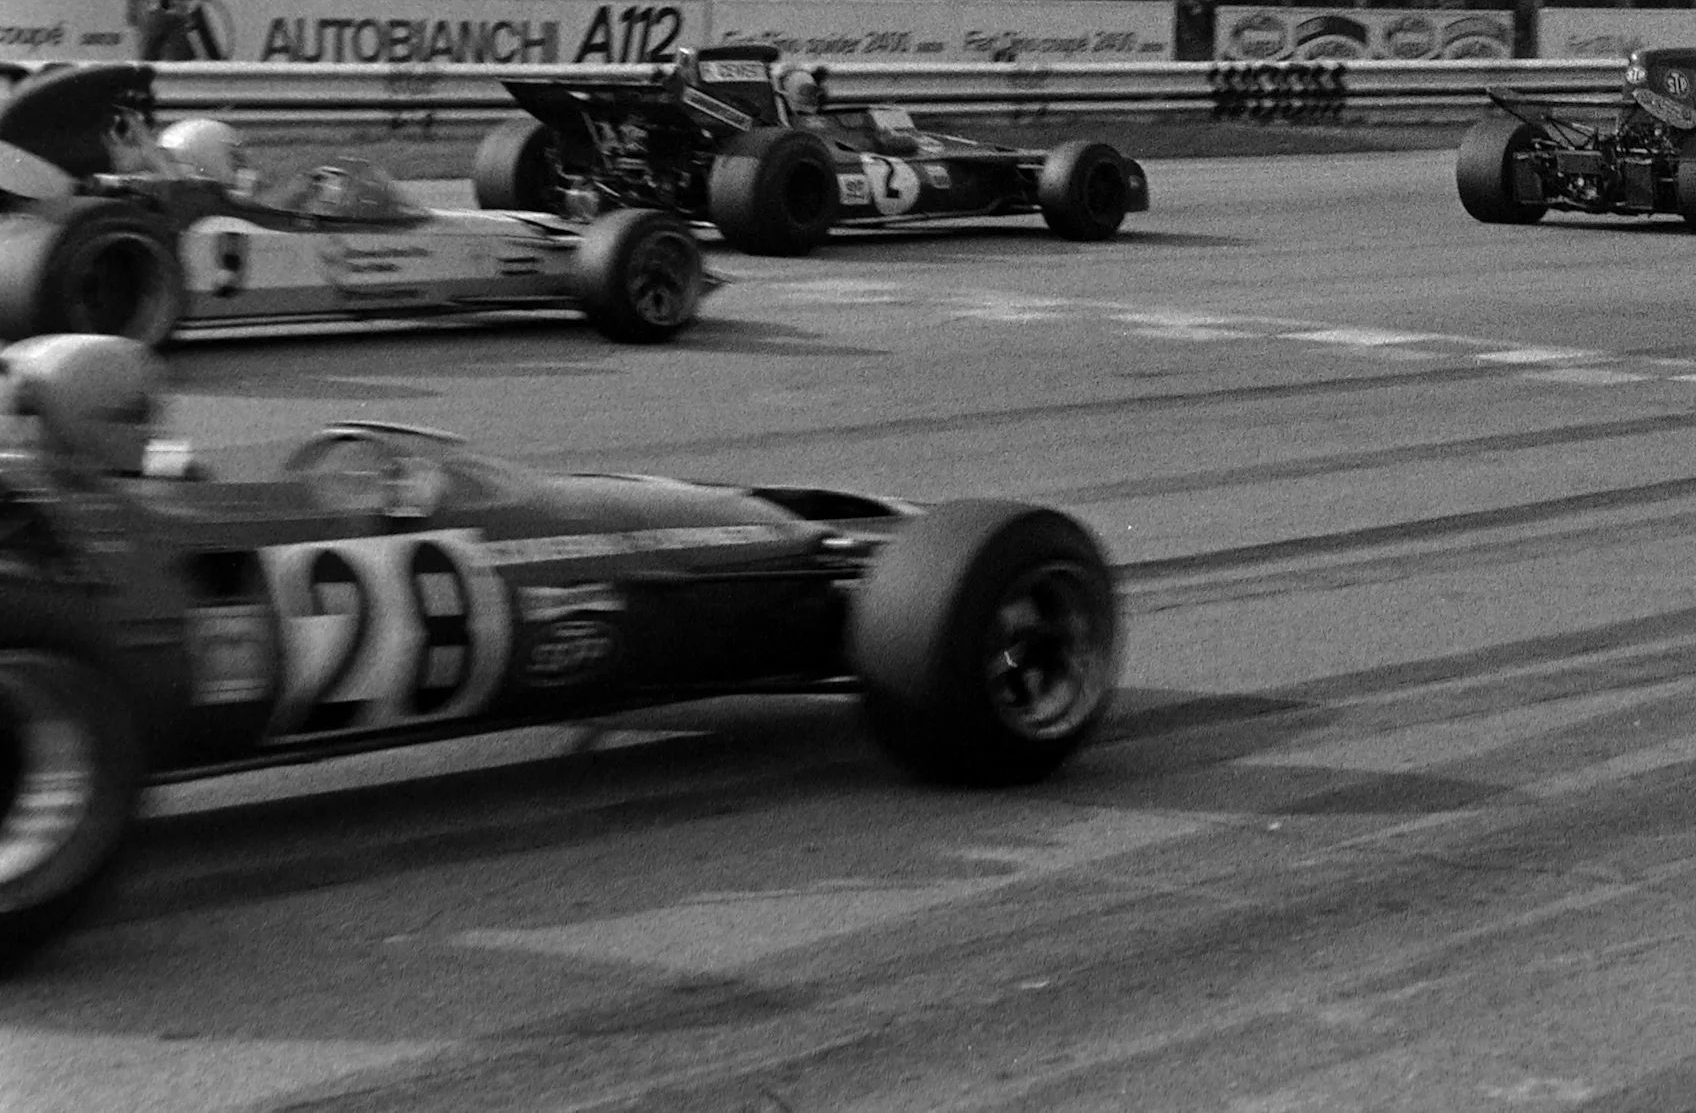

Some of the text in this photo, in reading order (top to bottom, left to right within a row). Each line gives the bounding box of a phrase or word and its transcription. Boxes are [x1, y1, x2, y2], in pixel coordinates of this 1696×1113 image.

[261, 5, 682, 63] AUTOBIANCHI A112
[1626, 66, 1646, 83] STP
[1667, 72, 1688, 95] STP
[872, 156, 900, 199] 2
